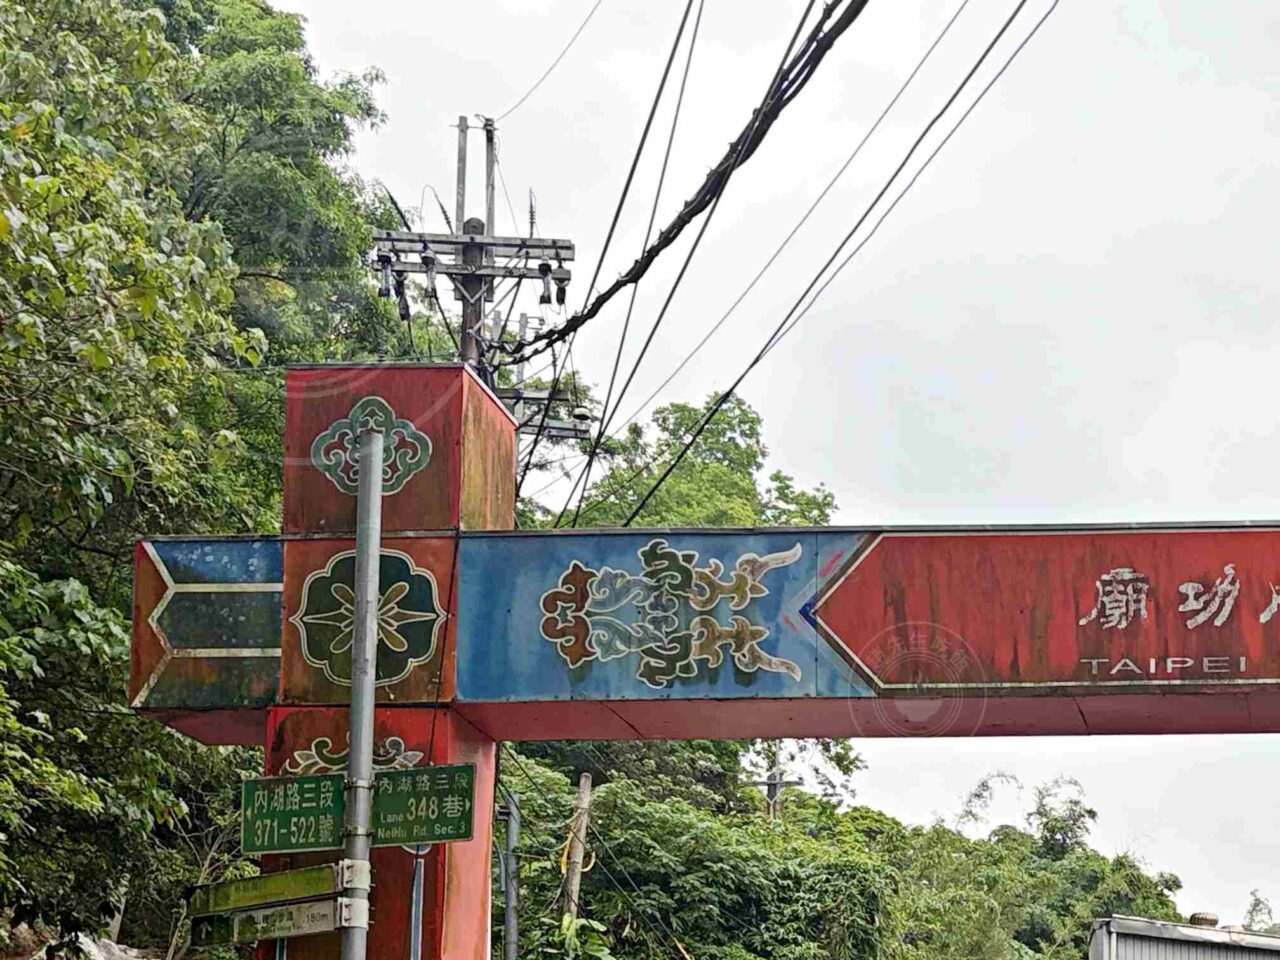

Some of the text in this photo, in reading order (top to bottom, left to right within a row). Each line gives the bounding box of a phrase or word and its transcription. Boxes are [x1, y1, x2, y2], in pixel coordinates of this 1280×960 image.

[1079, 656, 1247, 675] TAIPEI
[406, 794, 464, 821] 348巷
[380, 812, 404, 823] Lane
[459, 821, 466, 833] 3
[305, 911, 329, 924] 180m
